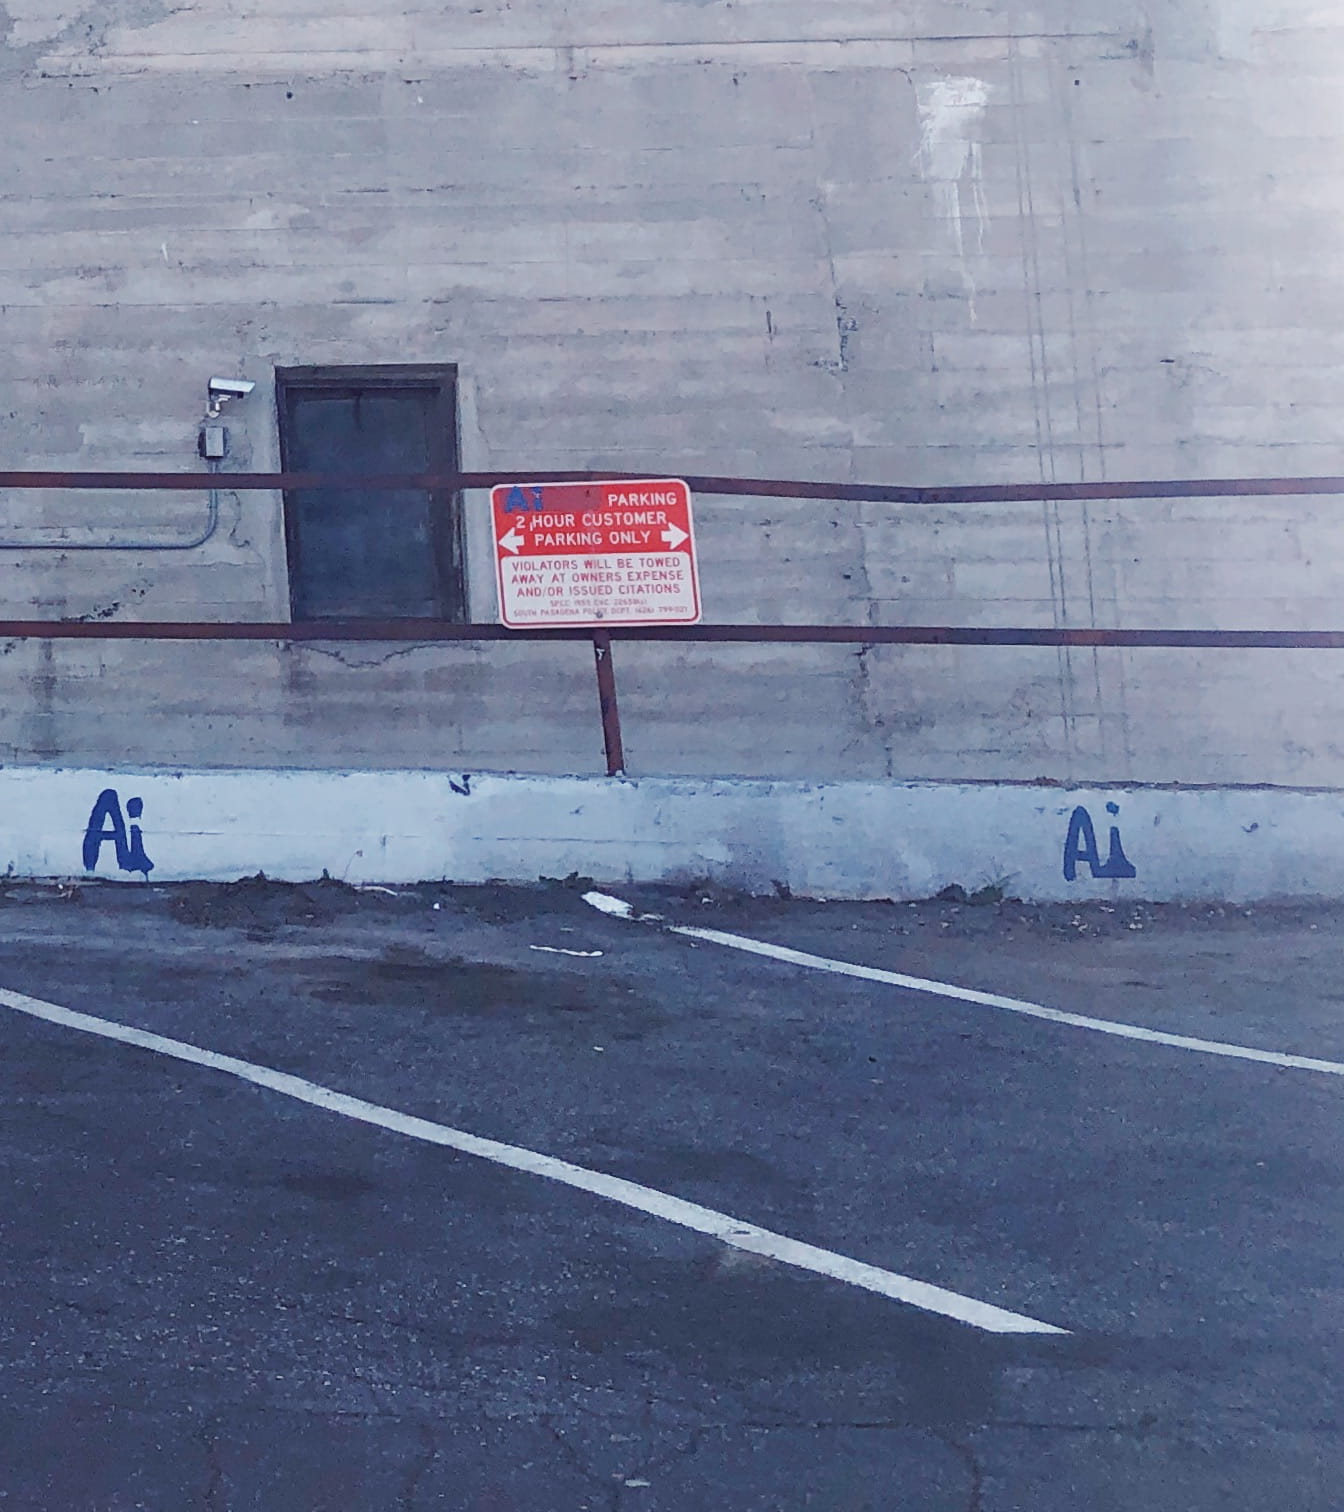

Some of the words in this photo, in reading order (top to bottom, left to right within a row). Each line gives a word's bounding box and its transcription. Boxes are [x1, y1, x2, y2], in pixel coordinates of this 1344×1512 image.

[608, 492, 677, 507] PARKING
[516, 515, 525, 529] 2
[532, 513, 575, 528] HOUR
[582, 511, 667, 526] CUSTOMER
[535, 532, 602, 546] PARKING
[609, 531, 651, 545] ONLY
[512, 559, 578, 572] VIOLATORS
[584, 559, 612, 569] WILL
[617, 558, 632, 569] BE
[640, 557, 680, 568] TOWED
[512, 573, 544, 584] AWAY
[552, 572, 566, 583] AT
[572, 571, 621, 582] OWNERS
[627, 569, 684, 581] EXPENSE
[517, 585, 563, 597] AND/OR
[569, 584, 613, 596] ISSUED
[618, 582, 680, 594] CITATIONS
[82, 787, 155, 881] Ai
[1063, 800, 1137, 883] Ai
